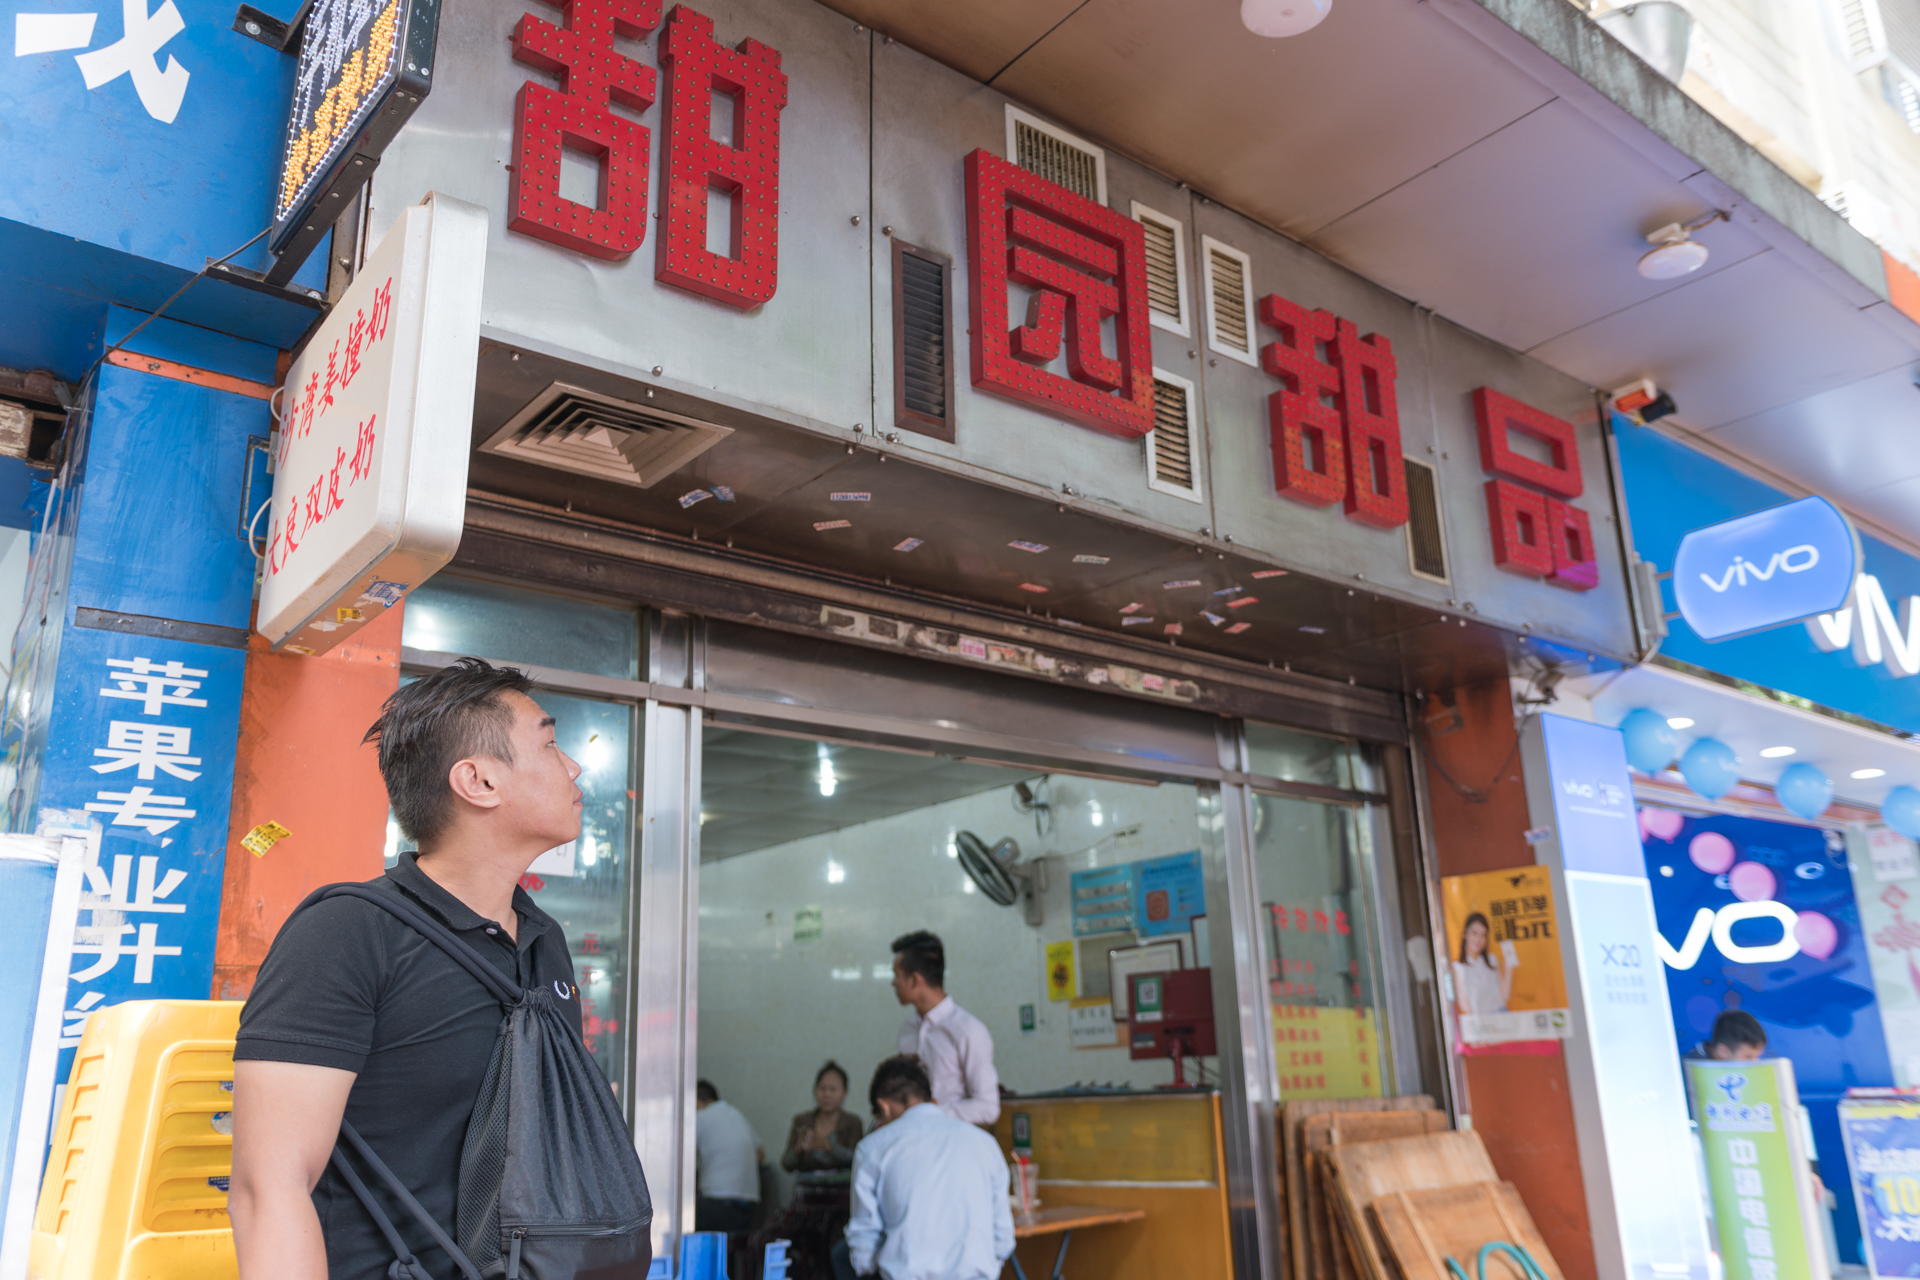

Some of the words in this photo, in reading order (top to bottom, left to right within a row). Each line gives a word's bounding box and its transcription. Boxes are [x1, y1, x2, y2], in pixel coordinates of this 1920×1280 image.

[508, 0, 1599, 591] 甜园甜品
[278, 276, 392, 471] 沙湾姜撞奶
[264, 413, 377, 584] 大良双皮奶
[1699, 544, 1820, 593] vivo
[581, 933, 600, 954] 元
[1599, 942, 1642, 968] X20
[581, 966, 598, 986] 元
